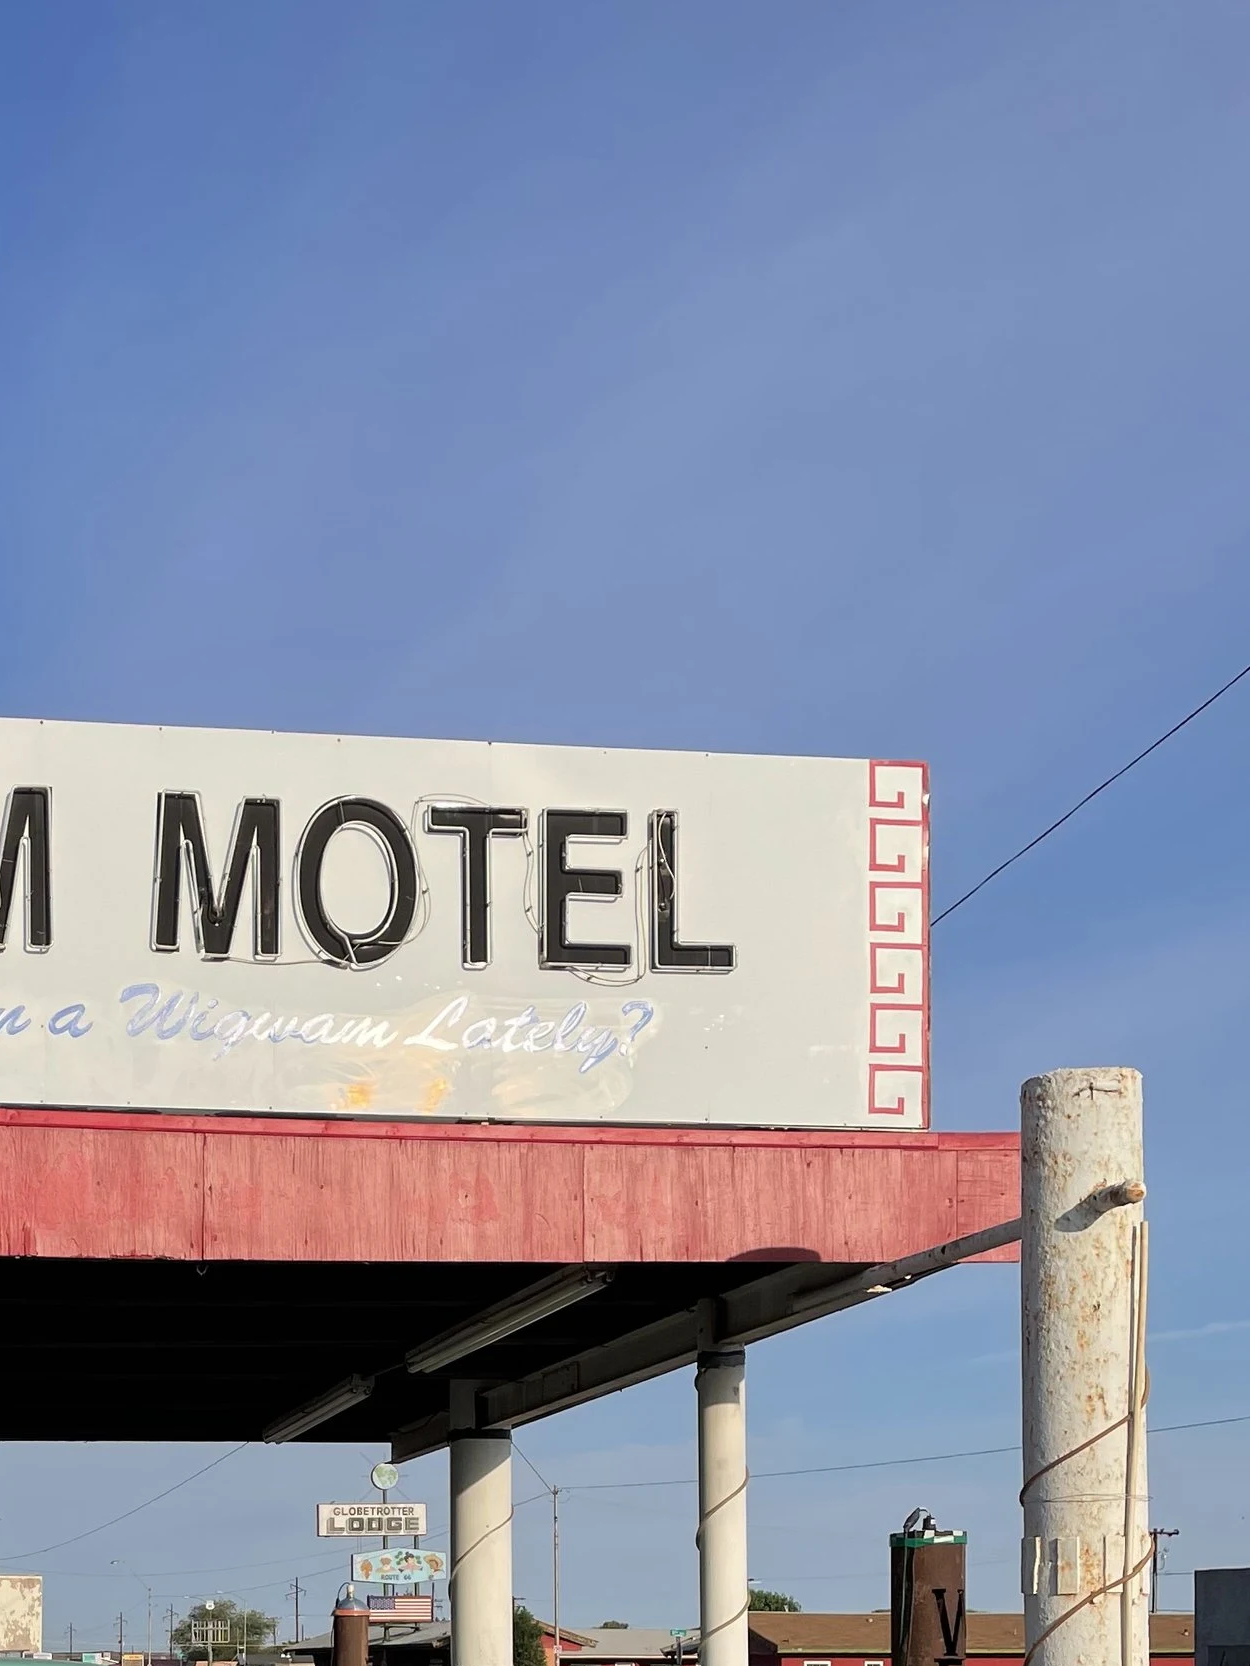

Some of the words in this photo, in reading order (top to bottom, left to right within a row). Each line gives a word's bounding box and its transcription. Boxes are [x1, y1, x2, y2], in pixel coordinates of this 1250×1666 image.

[151, 789, 738, 974] MOTEL
[48, 1003, 93, 1038] a
[119, 982, 399, 1061] Wigwam
[402, 996, 655, 1075] Lately?
[326, 1517, 420, 1534] LODGE
[333, 1506, 415, 1516] GLOBETROTTER
